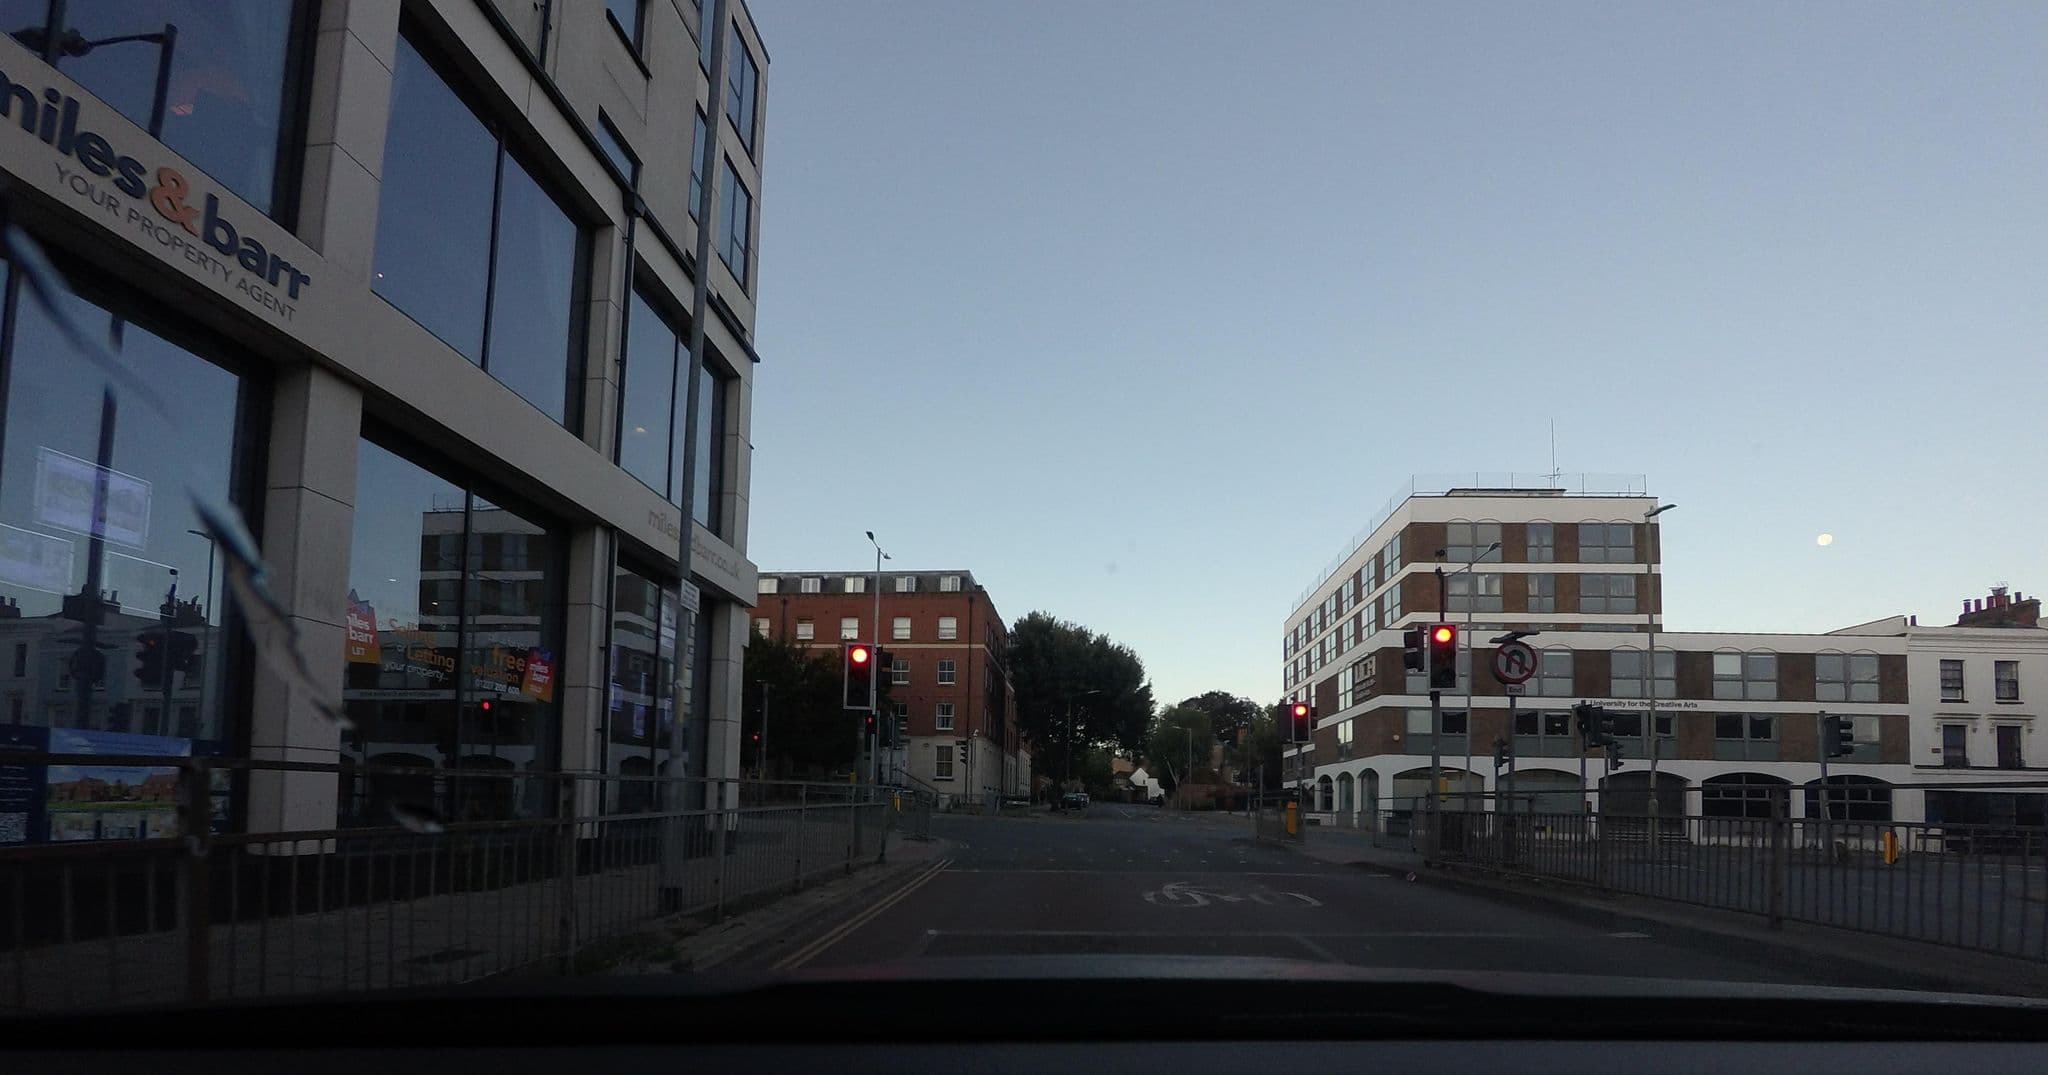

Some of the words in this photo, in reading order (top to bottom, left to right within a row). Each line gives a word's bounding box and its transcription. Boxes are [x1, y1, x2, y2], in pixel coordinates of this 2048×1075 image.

[55, 162, 120, 217] YOUR
[126, 207, 233, 283] PROPERTY
[235, 277, 297, 322] AGENT
[346, 613, 370, 631] iles
[384, 661, 406, 673] your
[407, 645, 456, 673] Letting
[1591, 699, 1626, 708] University
[1627, 699, 1638, 708] for
[1639, 699, 1651, 708] the
[1654, 700, 1683, 708] Creative
